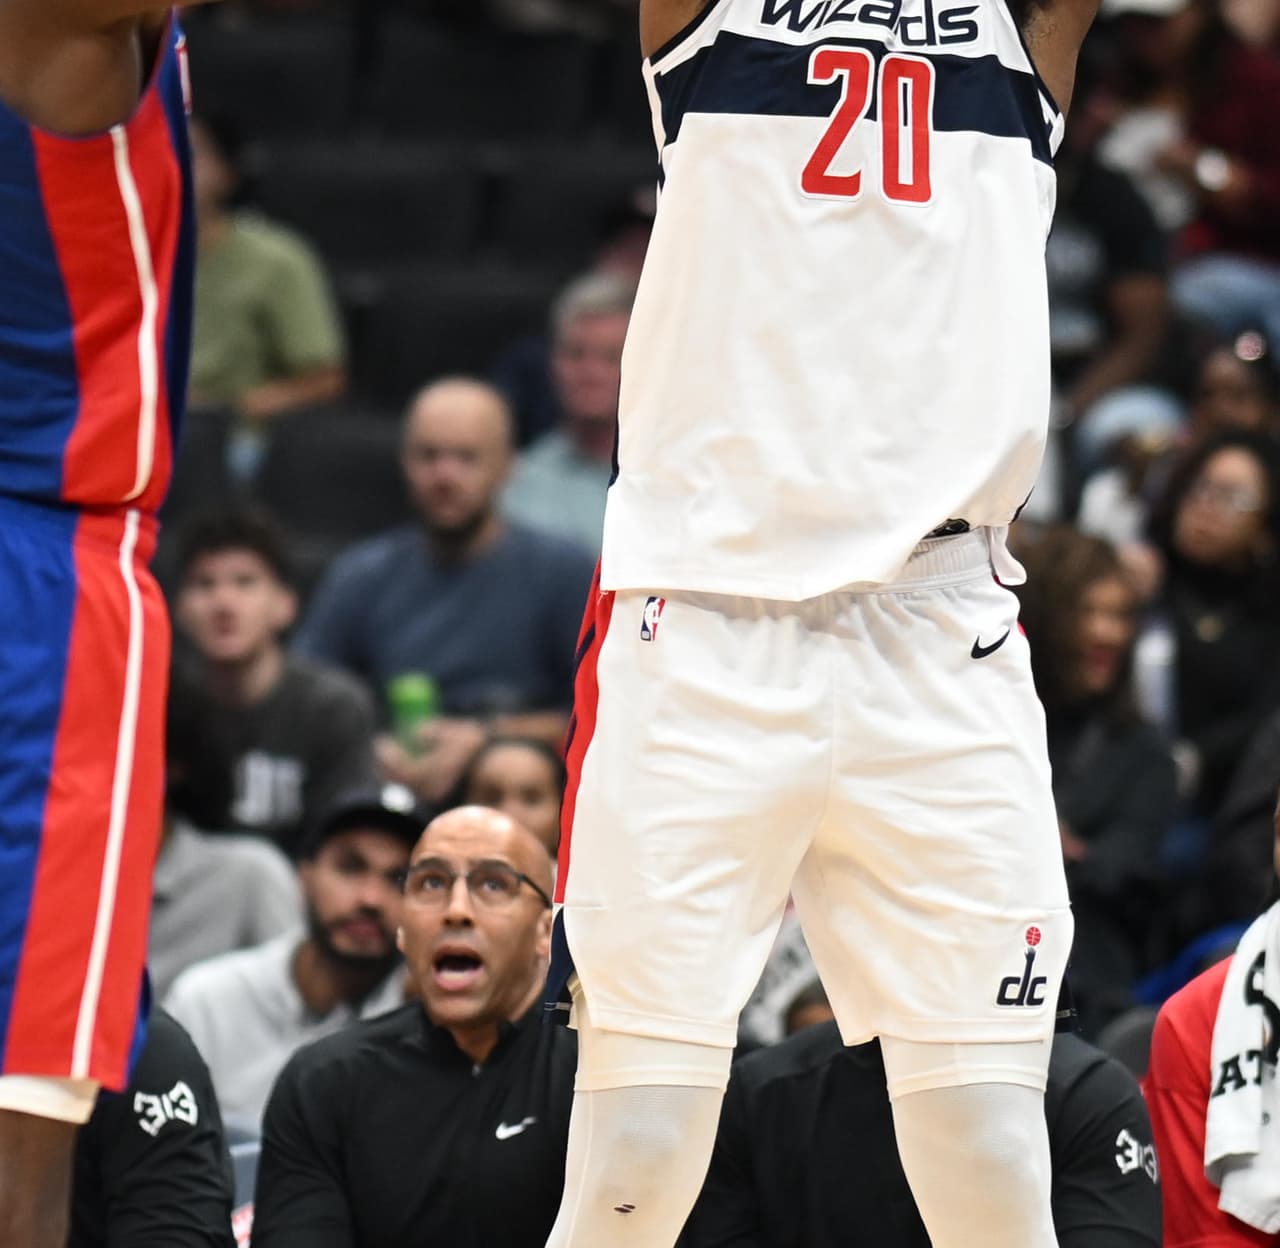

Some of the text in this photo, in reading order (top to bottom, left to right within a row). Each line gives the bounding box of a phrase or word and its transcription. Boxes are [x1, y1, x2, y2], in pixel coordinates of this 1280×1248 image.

[801, 45, 936, 207] 20
[996, 947, 1047, 1006] dc
[133, 1080, 198, 1136] 313
